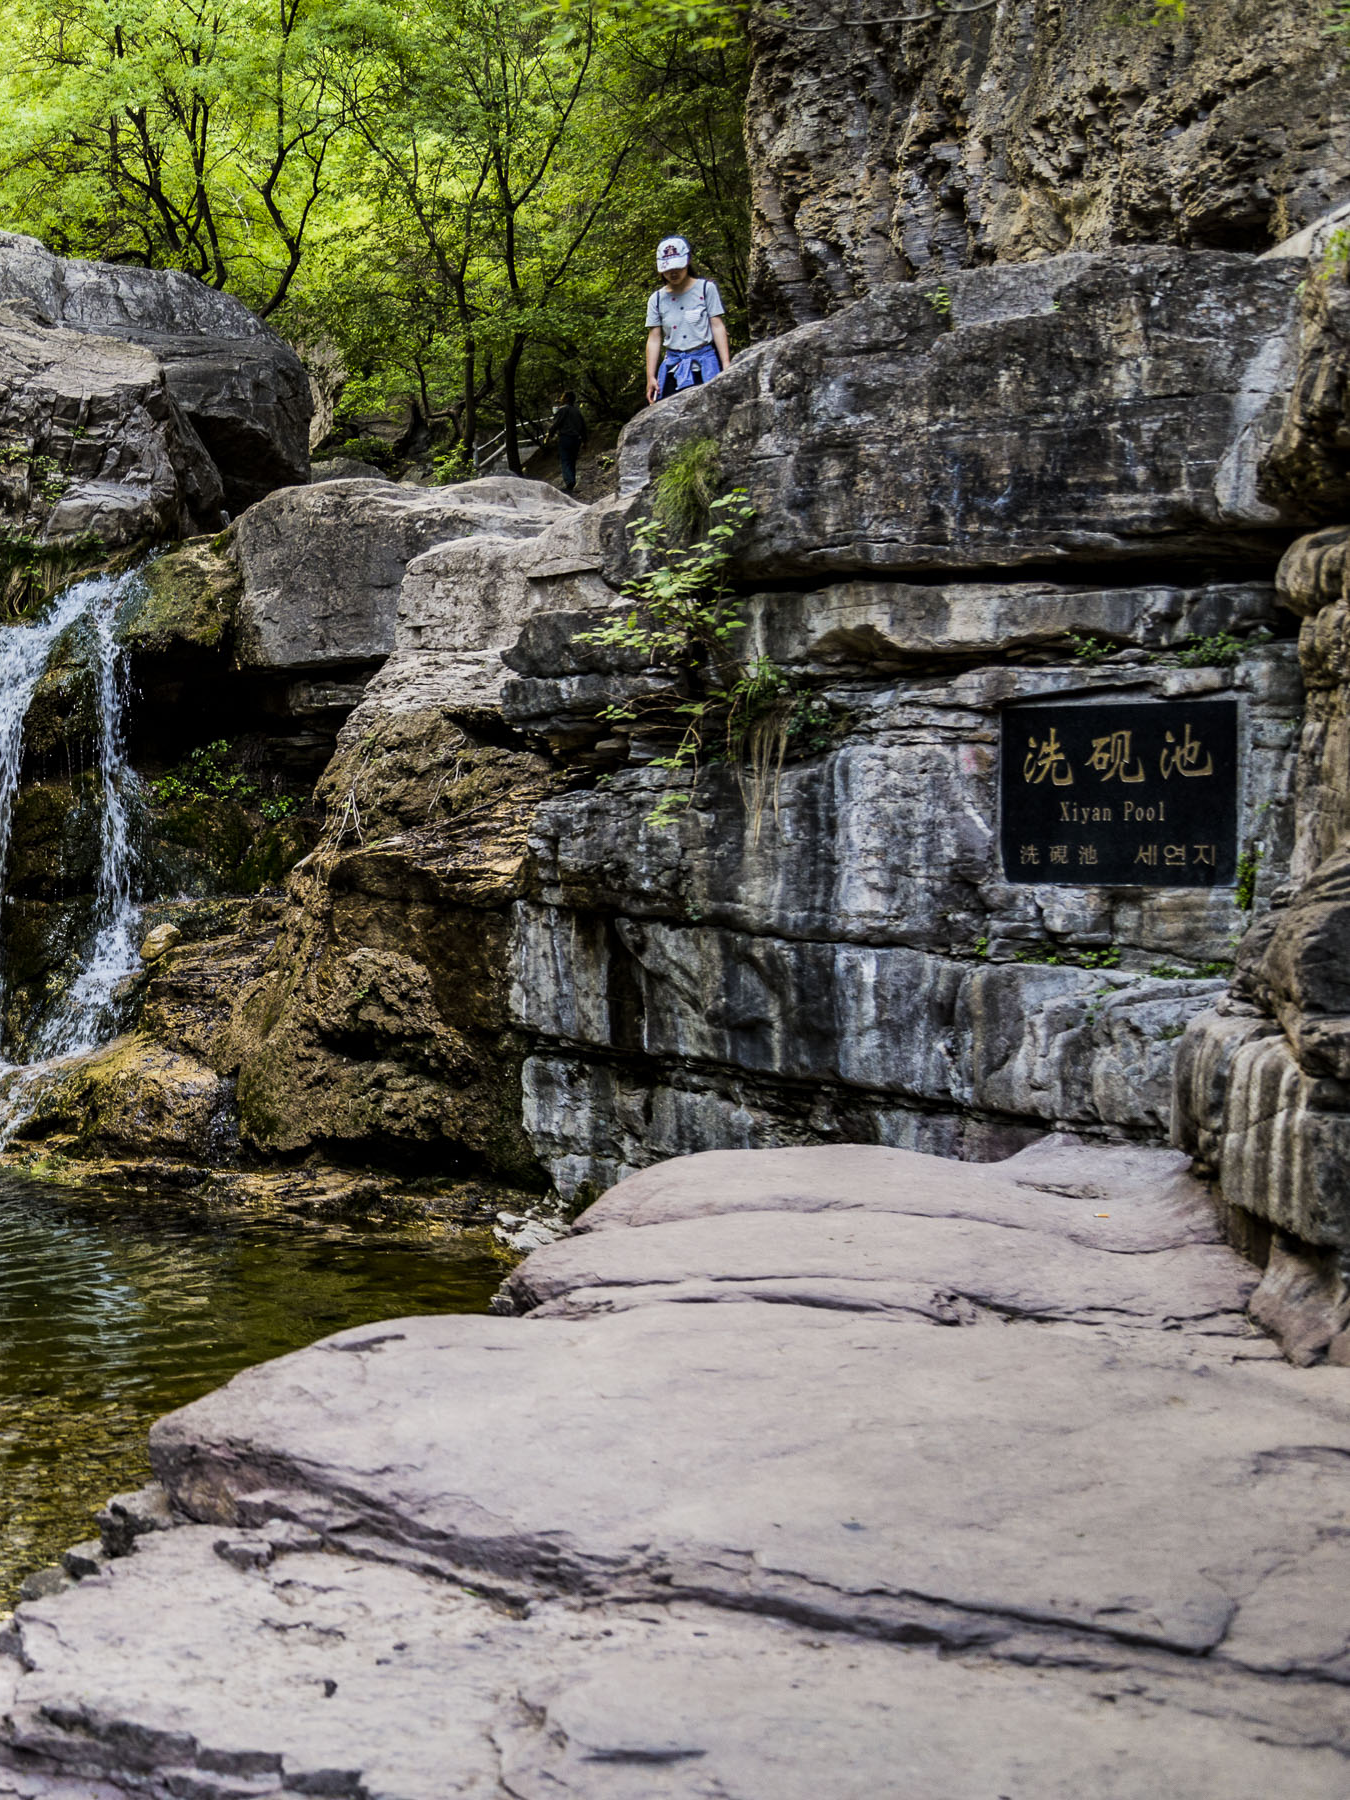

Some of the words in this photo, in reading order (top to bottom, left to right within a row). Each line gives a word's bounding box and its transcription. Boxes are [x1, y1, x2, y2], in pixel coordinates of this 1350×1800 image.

[1023, 723, 1213, 786] 洗砚池
[1059, 801, 1112, 824] Xiyan
[1123, 800, 1166, 822] Pool
[1134, 844, 1216, 866] 세연지
